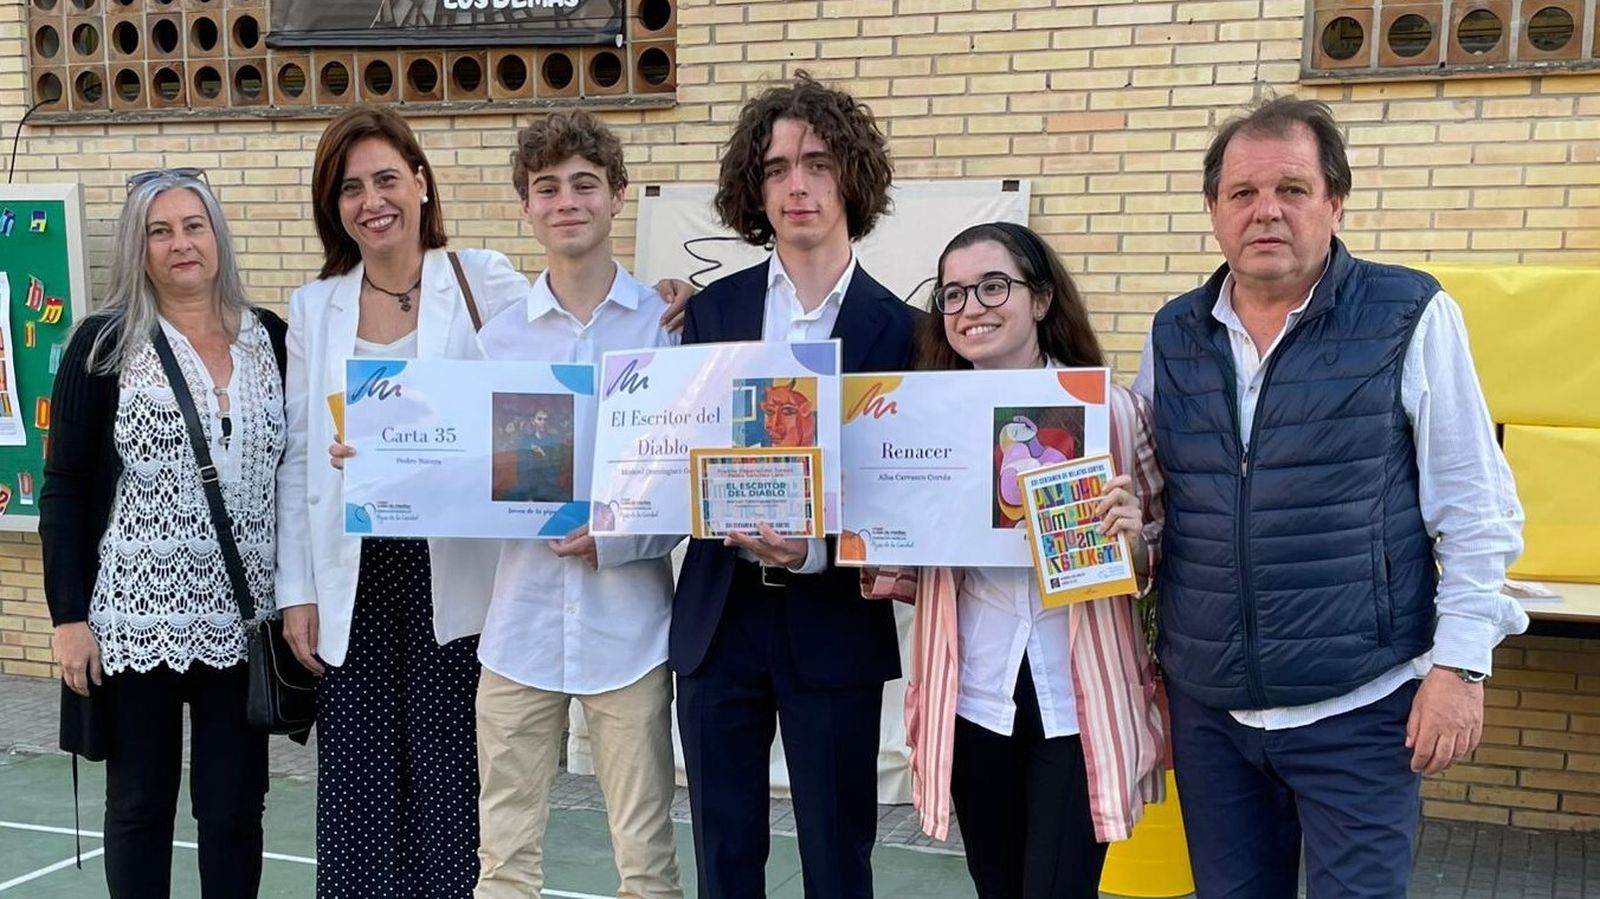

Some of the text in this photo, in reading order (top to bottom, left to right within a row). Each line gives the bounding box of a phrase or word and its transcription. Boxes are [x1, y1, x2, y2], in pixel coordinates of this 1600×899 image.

[611, 407, 720, 427] El Escritor del
[382, 426, 457, 443] Carta 35
[638, 438, 688, 456] Diablo
[882, 442, 952, 459] Renacer
[727, 481, 787, 490] EL ESCRITOR
[749, 489, 785, 497] DIABLO
